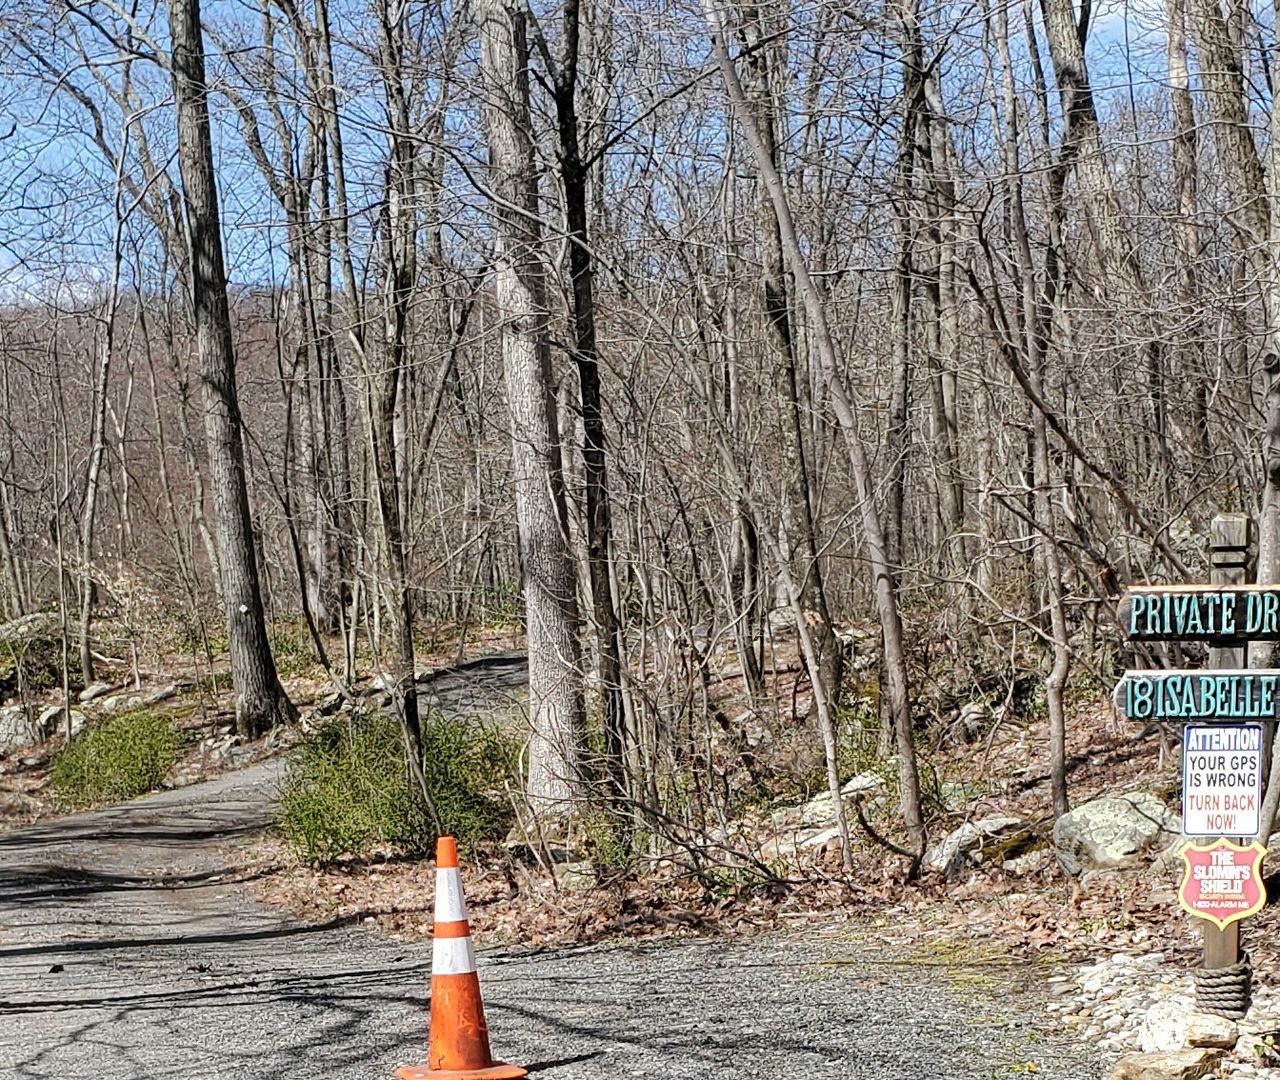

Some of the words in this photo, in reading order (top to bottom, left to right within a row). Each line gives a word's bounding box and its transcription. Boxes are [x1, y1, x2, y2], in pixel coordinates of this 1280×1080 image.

[1130, 592, 1236, 635] PRIVATE
[1125, 678, 1153, 718] 18
[1156, 676, 1276, 718] ISABELLE
[1187, 728, 1259, 750] ATTENTION
[1189, 756, 1226, 770] YOUR
[1230, 756, 1257, 770] GPS
[1189, 773, 1202, 787] IS
[1206, 773, 1256, 787] WRONG
[1189, 795, 1220, 810] TURN
[1224, 795, 1255, 810] BACK
[1206, 814, 1237, 830] NOW!
[1210, 851, 1235, 865] THE
[1193, 865, 1251, 880] SLOMIN'S
[1200, 880, 1244, 894] SHIELD
